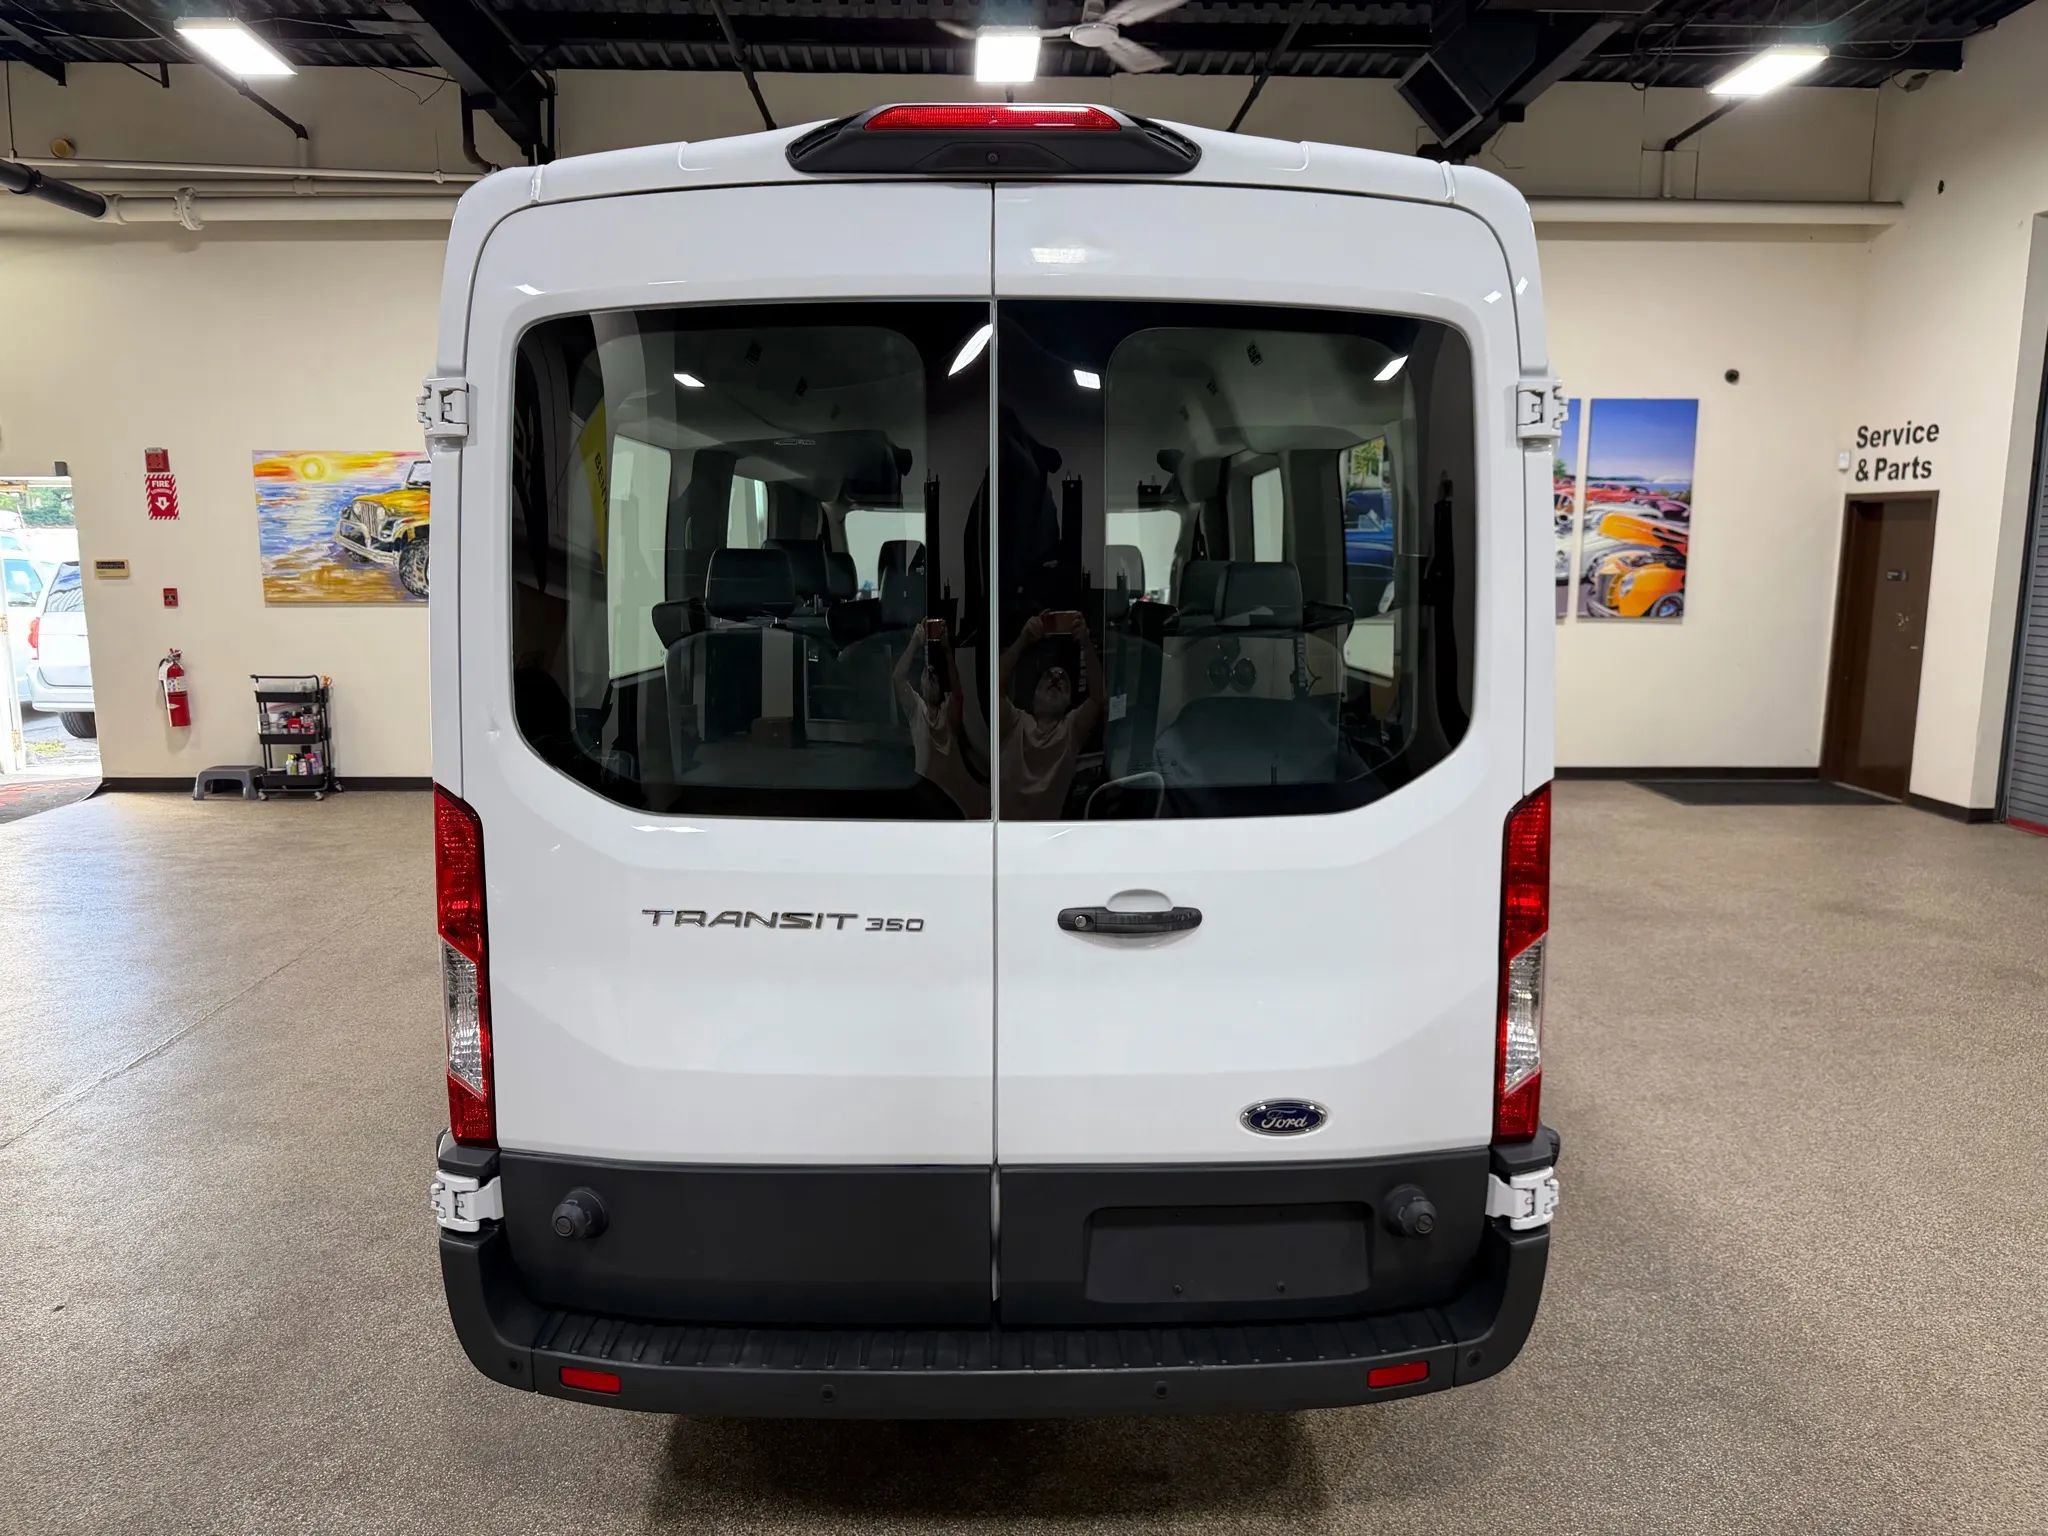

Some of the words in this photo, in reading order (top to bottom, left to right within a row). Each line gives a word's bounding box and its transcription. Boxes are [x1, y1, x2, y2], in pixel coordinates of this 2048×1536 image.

[1856, 420, 1939, 449] Service
[1855, 458, 1869, 482] &
[1874, 456, 1932, 481] Parts
[151, 480, 170, 488] FIRE
[642, 909, 858, 931] TRANSIT
[865, 917, 924, 932] 350
[1261, 1109, 1309, 1129] Ford
